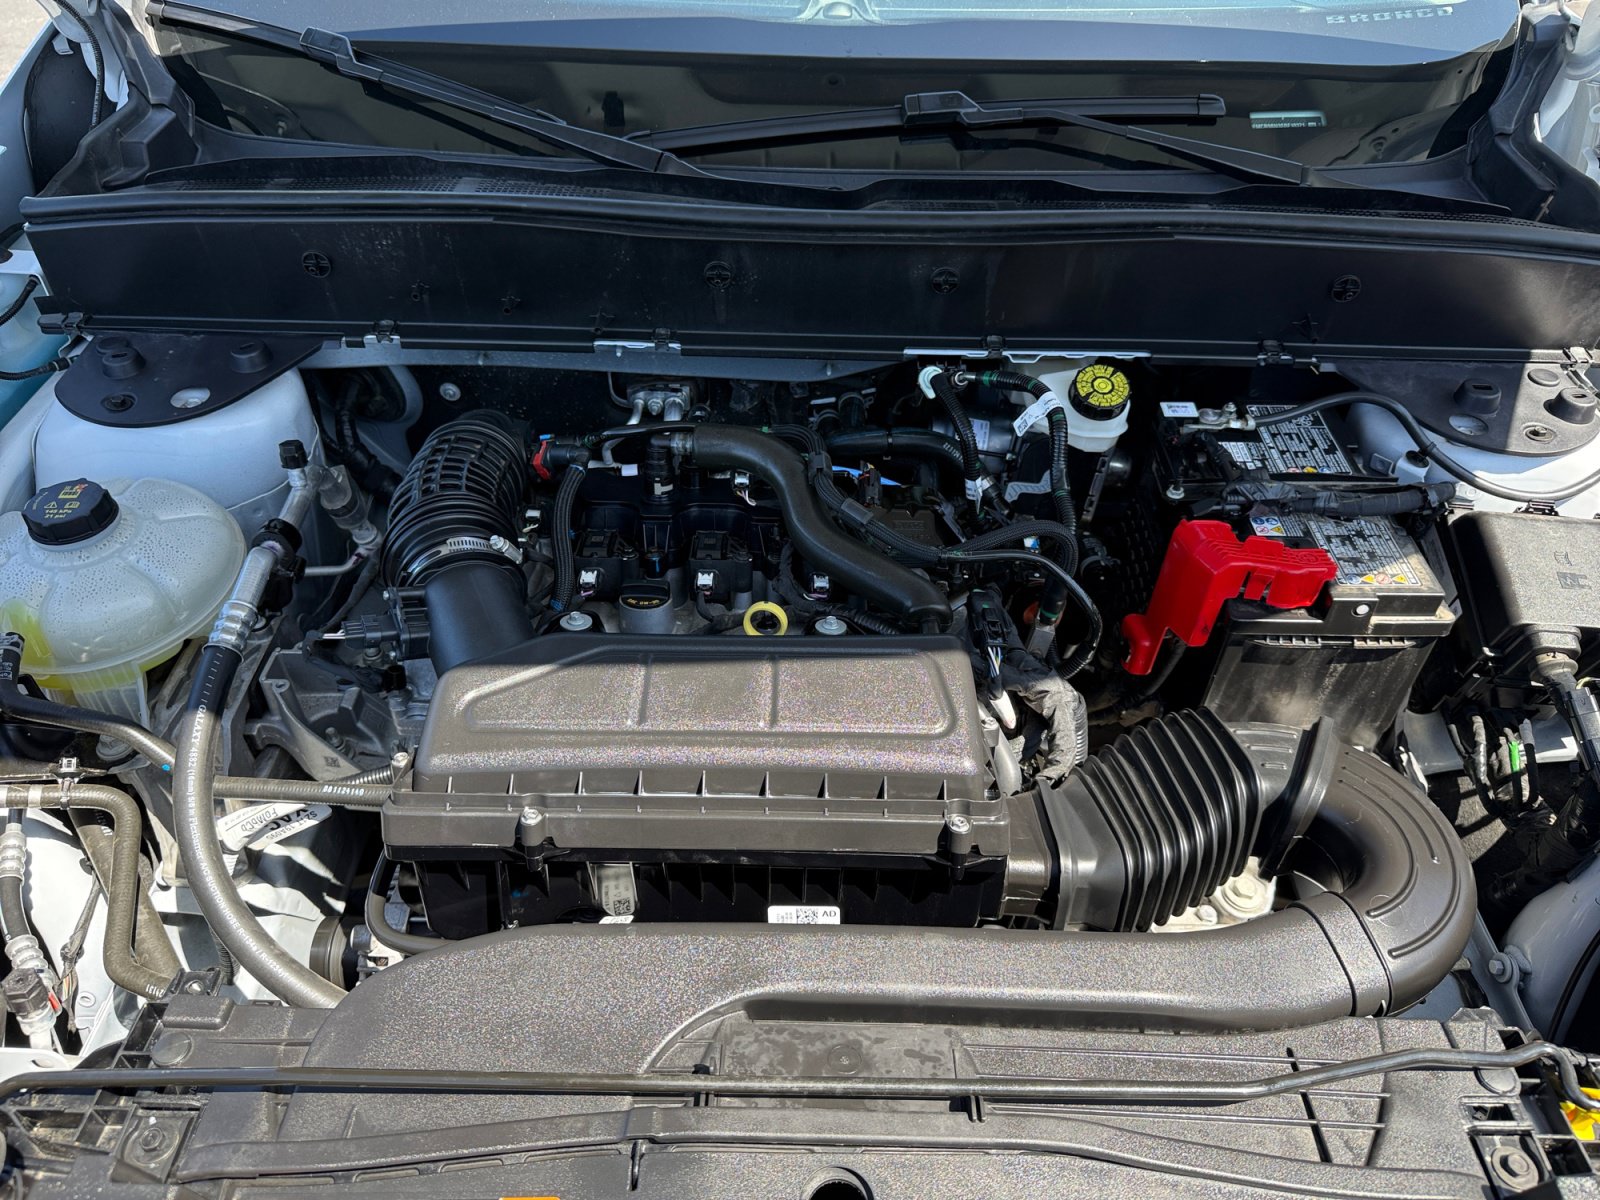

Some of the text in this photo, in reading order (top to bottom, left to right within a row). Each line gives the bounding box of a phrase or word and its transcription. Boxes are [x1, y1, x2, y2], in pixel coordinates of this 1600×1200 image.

[1325, 6, 1453, 24] BRONCO
[191, 704, 207, 746] GALAXY
[188, 747, 198, 768] 4882
[188, 817, 204, 860] Flexbarrier
[206, 875, 227, 909] SUCTION
[222, 908, 241, 929] HOSE
